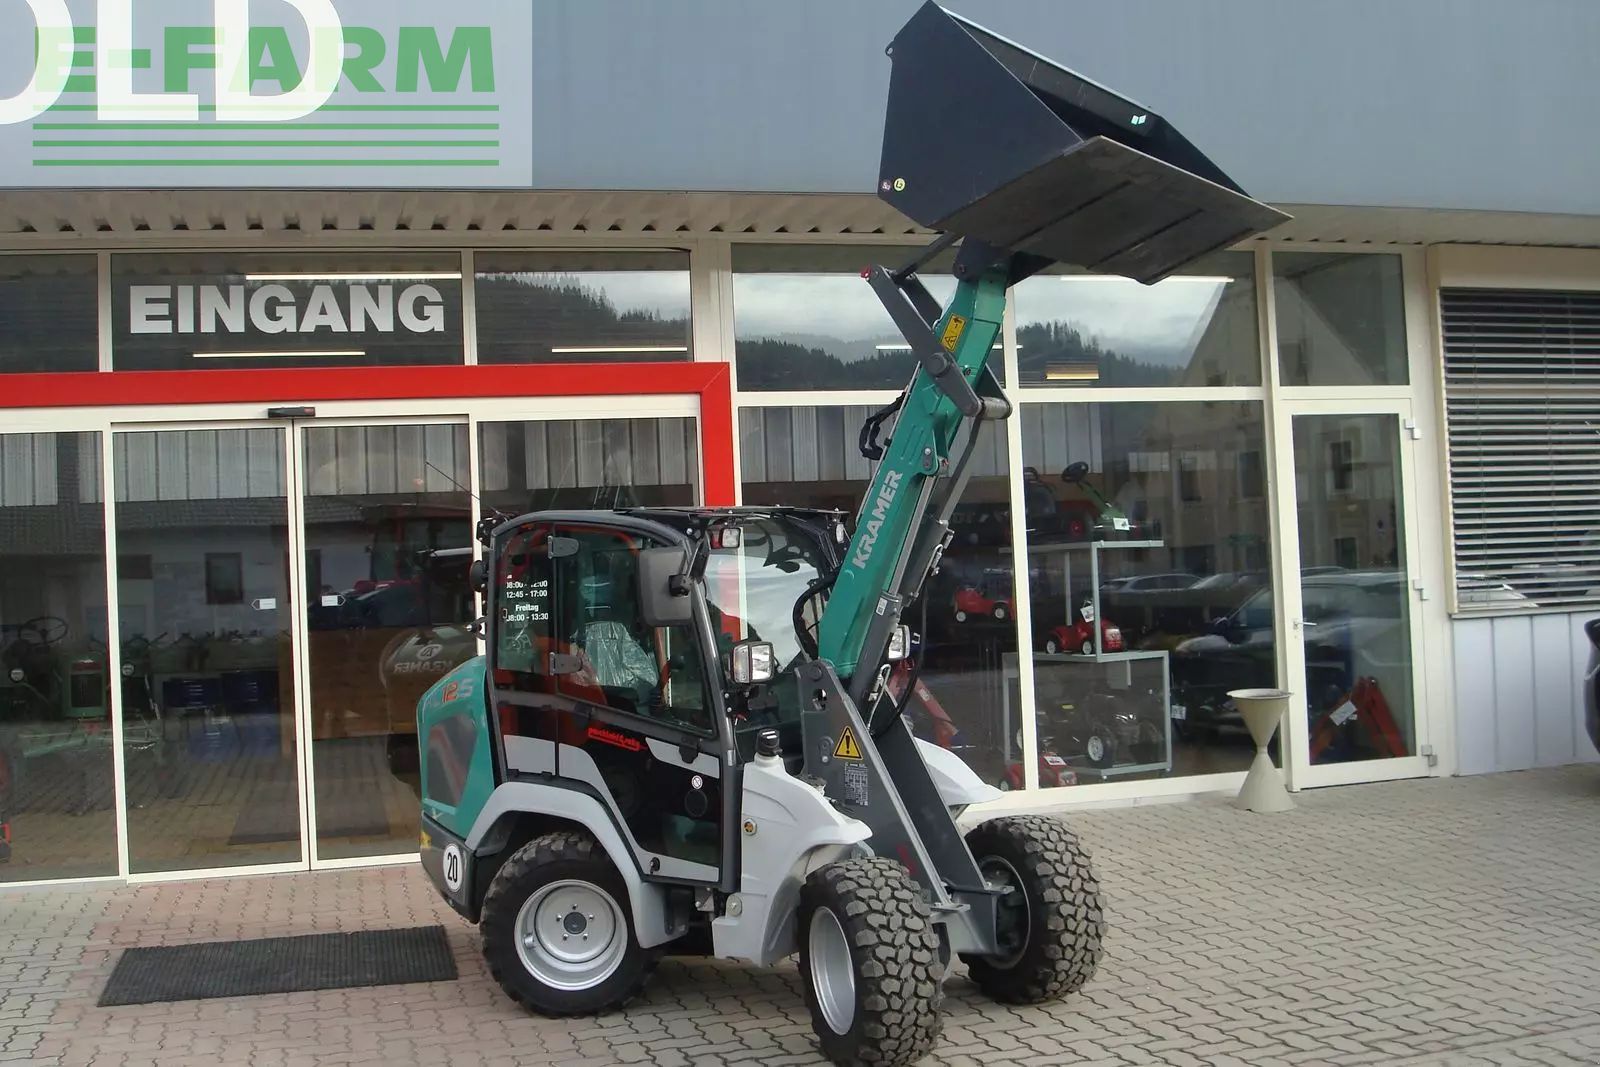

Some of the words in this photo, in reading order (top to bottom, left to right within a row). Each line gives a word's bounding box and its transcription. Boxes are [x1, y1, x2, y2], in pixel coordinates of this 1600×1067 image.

[130, 284, 445, 333] EINGANG
[852, 470, 903, 569] KRAMER
[530, 580, 548, 588] 2:00
[506, 590, 524, 598] 12:45
[530, 589, 548, 597] 17:00
[515, 603, 539, 612] Freitag
[531, 612, 549, 621] 13:30
[447, 852, 458, 883] 20
